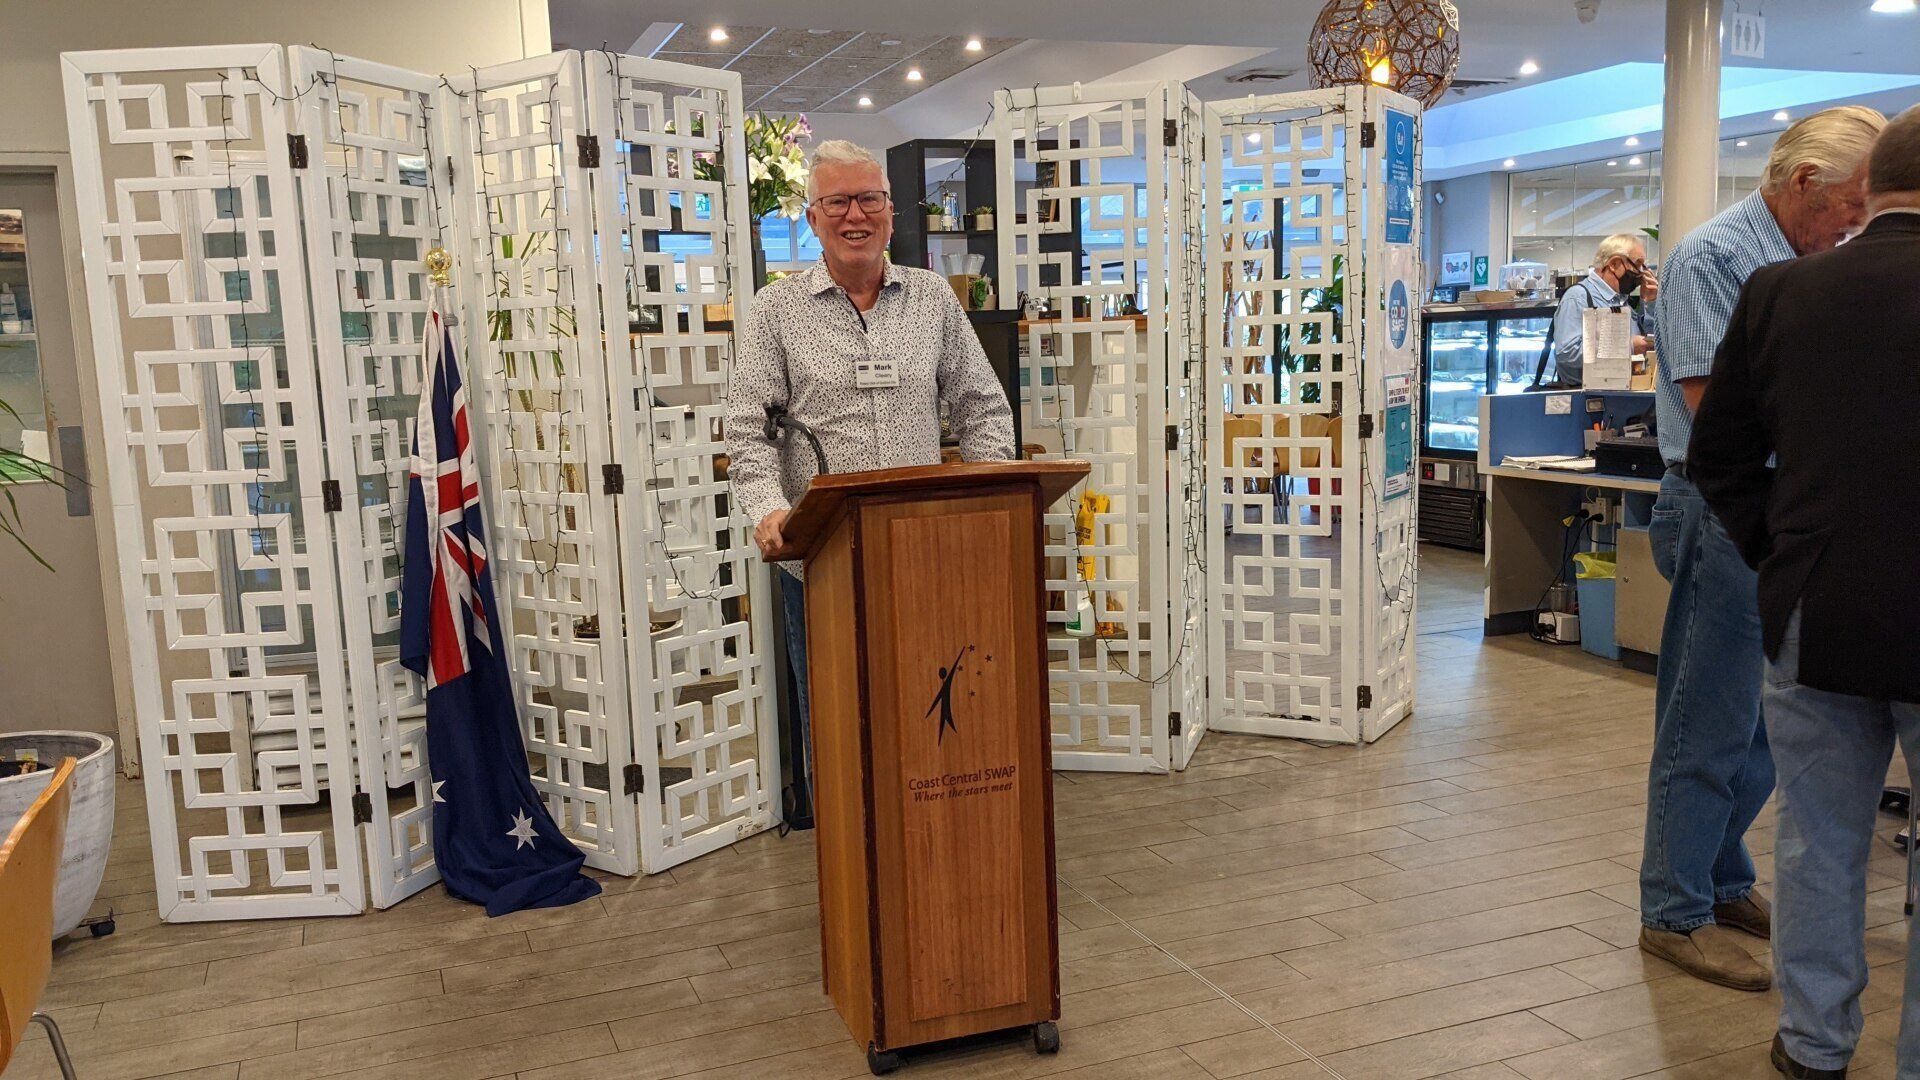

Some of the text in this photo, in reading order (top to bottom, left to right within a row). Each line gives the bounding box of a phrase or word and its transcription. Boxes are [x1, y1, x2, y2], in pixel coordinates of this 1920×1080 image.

[908, 765, 1016, 791] Coast Central SWAP
[914, 782, 1013, 803] Where the stars meet
